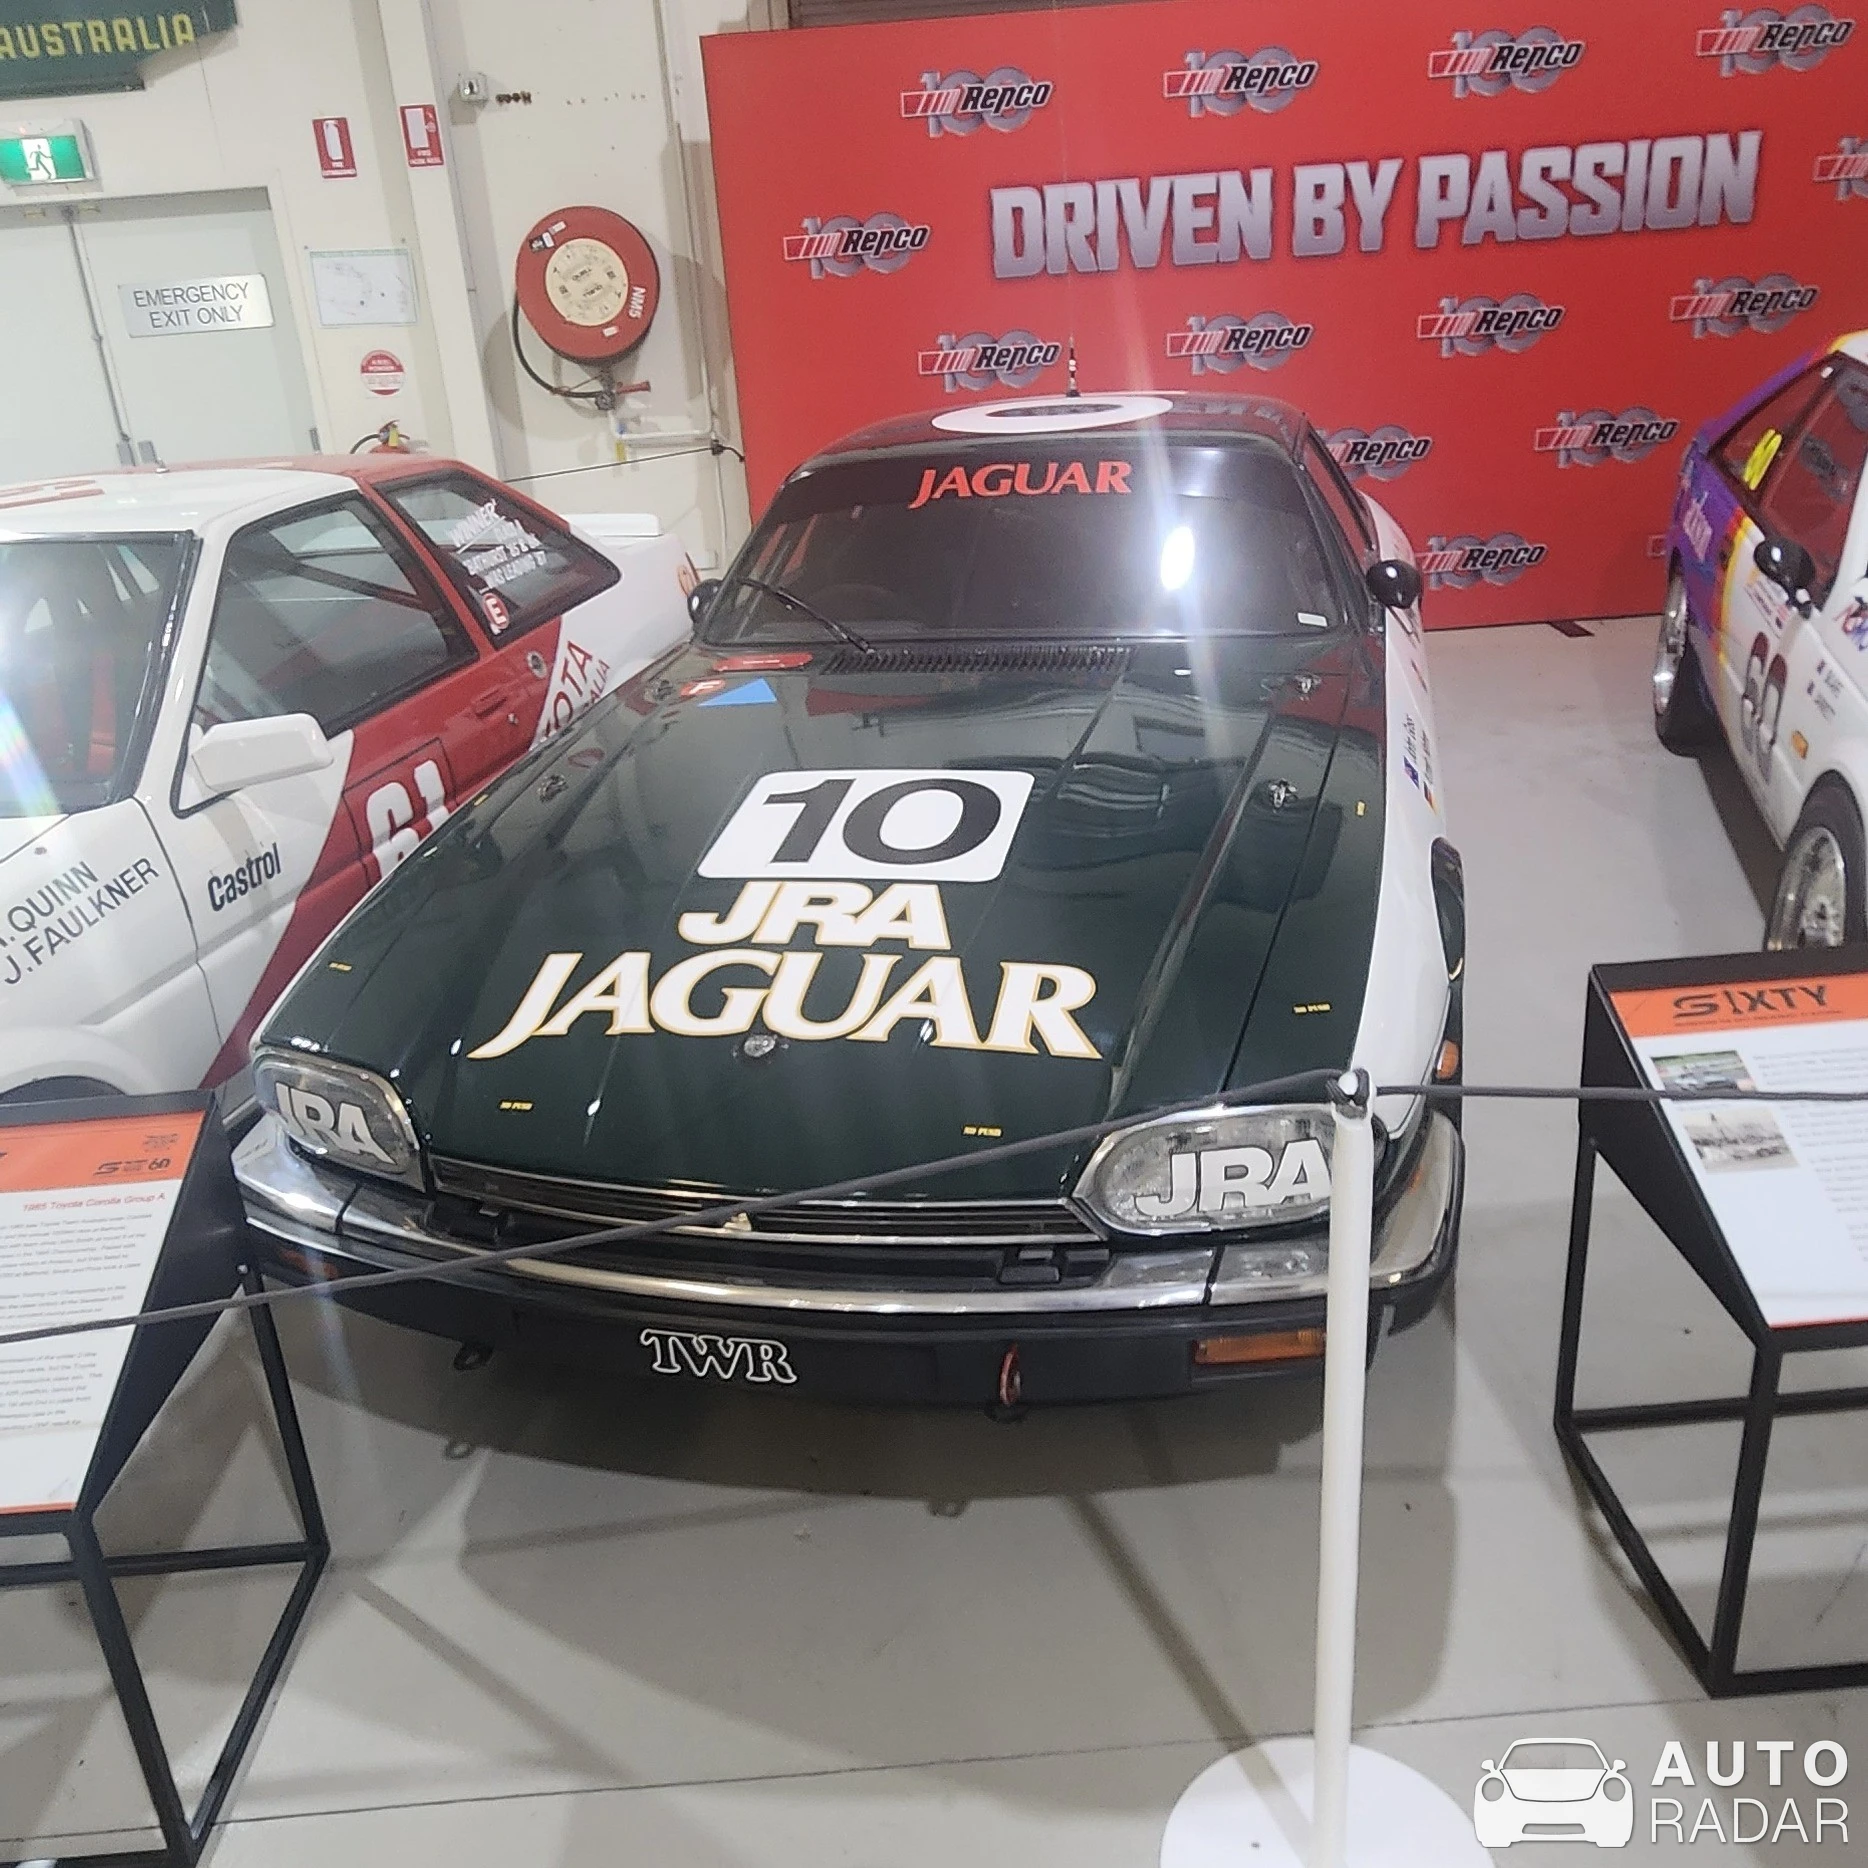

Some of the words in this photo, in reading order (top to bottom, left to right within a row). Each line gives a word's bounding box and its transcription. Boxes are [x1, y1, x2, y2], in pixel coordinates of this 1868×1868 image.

[0, 13, 195, 60] AUSTRALIA
[1758, 18, 1854, 53] Repco
[1491, 41, 1583, 74] Repco
[1224, 61, 1318, 97] Repco
[961, 81, 1052, 115] Repco
[990, 167, 1273, 281] DRIVEN
[1292, 158, 1403, 257] BY
[1415, 130, 1763, 249] PASSION
[843, 224, 930, 256] Repco
[134, 282, 249, 308] EMERGENCY
[1729, 285, 1818, 316] Repco
[150, 308, 191, 329] EXIT
[197, 305, 243, 326] ONLY
[1476, 304, 1564, 336] Repco
[1224, 323, 1313, 355] Repco
[976, 343, 1061, 372] Repco
[1591, 419, 1680, 446] Repco
[1346, 438, 1431, 465] Repco
[908, 461, 1133, 509] JAGUAR
[1461, 545, 1546, 570] Repco
[763, 778, 1001, 865] 10
[207, 842, 282, 912] Castrol
[678, 881, 951, 951] JRA
[467, 950, 1103, 1060] JAGUAR
[1673, 984, 1827, 1019] SIXTY
[276, 1082, 396, 1165] JRA
[1134, 1138, 1332, 1218] JRA
[50, 1201, 83, 1210] Toyota
[640, 1330, 798, 1385] TWR
